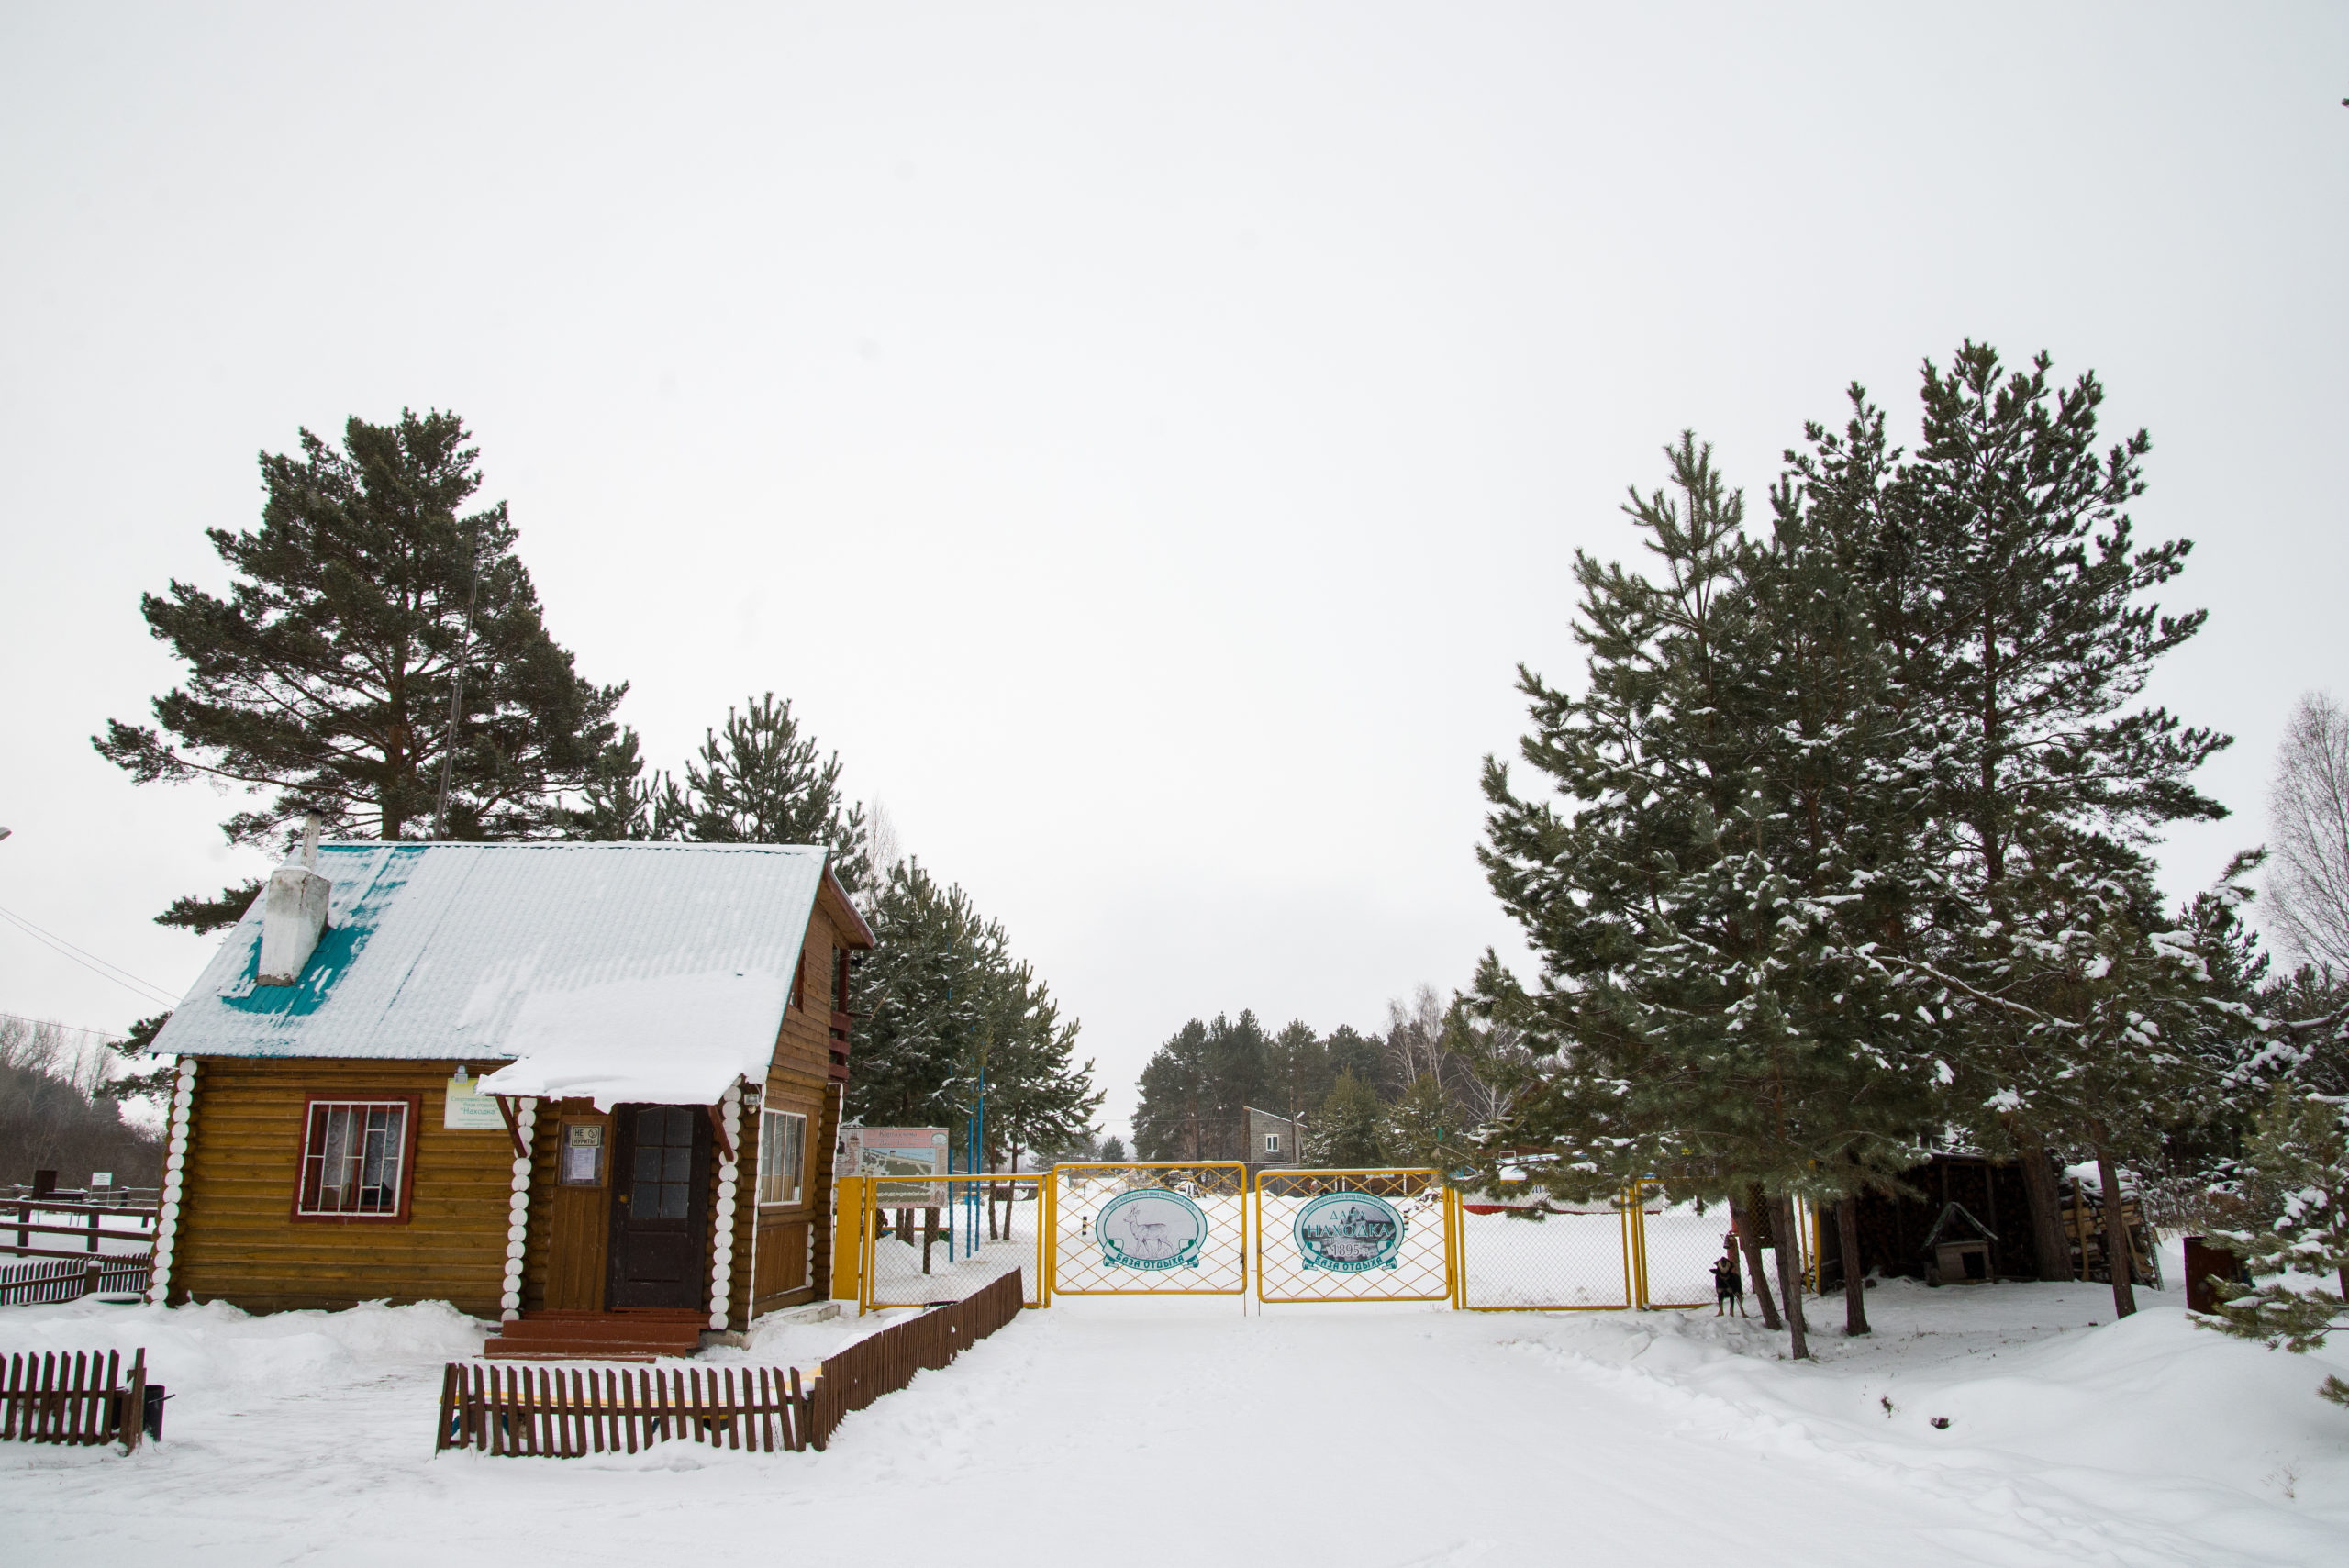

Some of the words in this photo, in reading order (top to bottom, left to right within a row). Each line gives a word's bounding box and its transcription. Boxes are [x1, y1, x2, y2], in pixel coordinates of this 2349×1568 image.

[573, 1129, 584, 1137] НЕ
[1307, 1223, 1391, 1238] НАХОДКА
[1331, 1243, 1360, 1256] 1895
[1115, 1253, 1141, 1267] БАЗА
[1143, 1254, 1185, 1269] ОТДЫХА
[1314, 1256, 1340, 1271] БАЗА
[1342, 1256, 1383, 1271] ОТДЫХА
